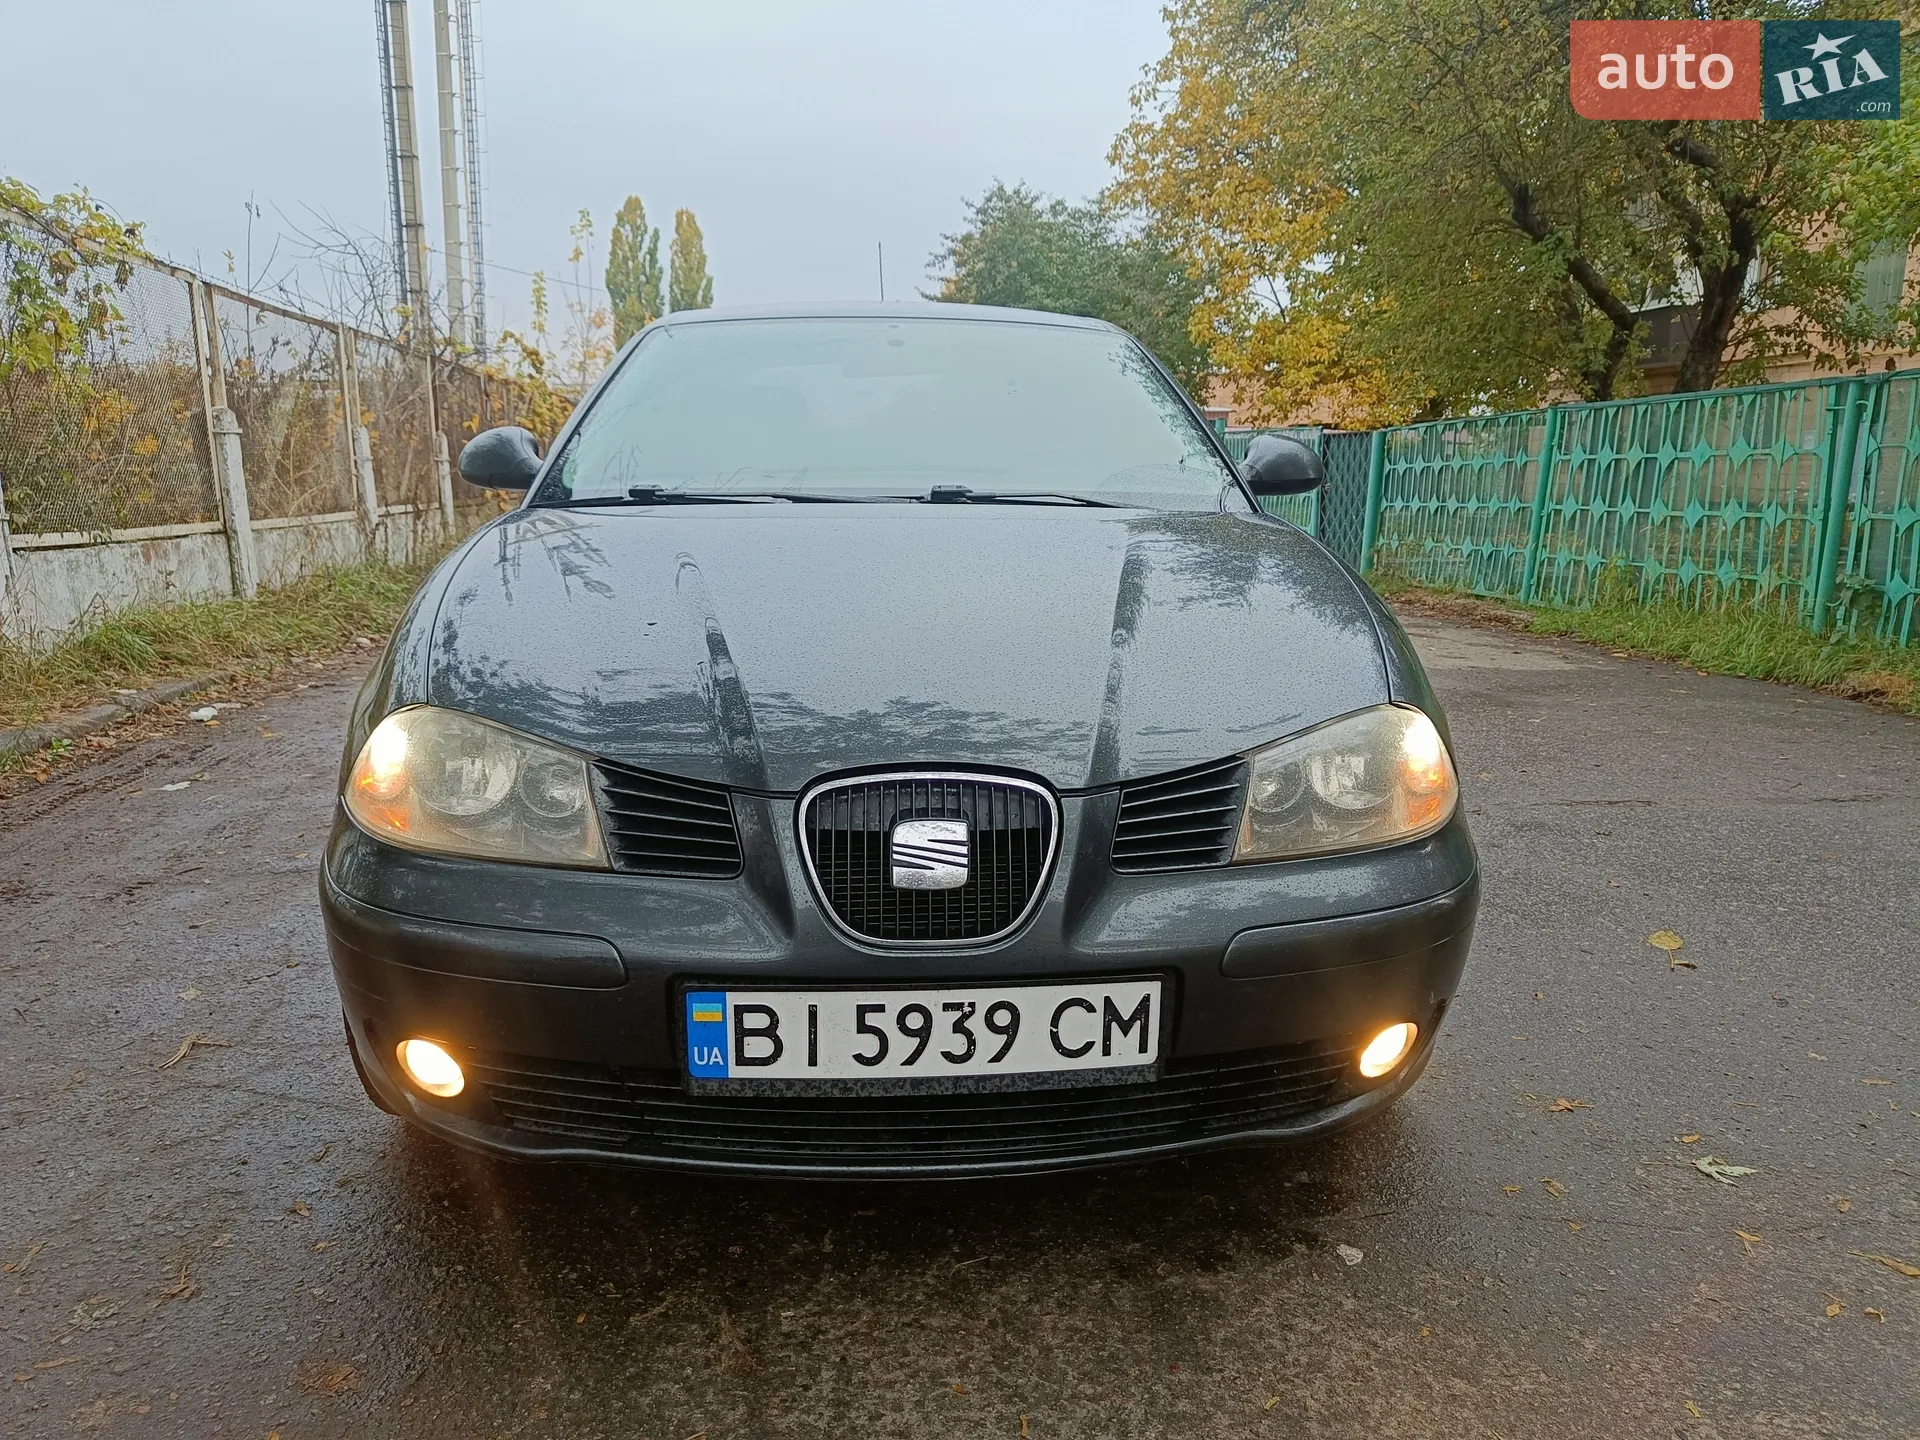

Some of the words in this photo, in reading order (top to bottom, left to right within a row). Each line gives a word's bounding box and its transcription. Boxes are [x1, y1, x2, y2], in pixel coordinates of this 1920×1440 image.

[733, 1003, 818, 1067] BI
[852, 1001, 1021, 1066] 5939
[1049, 993, 1151, 1059] CM
[693, 1046, 724, 1066] UA
